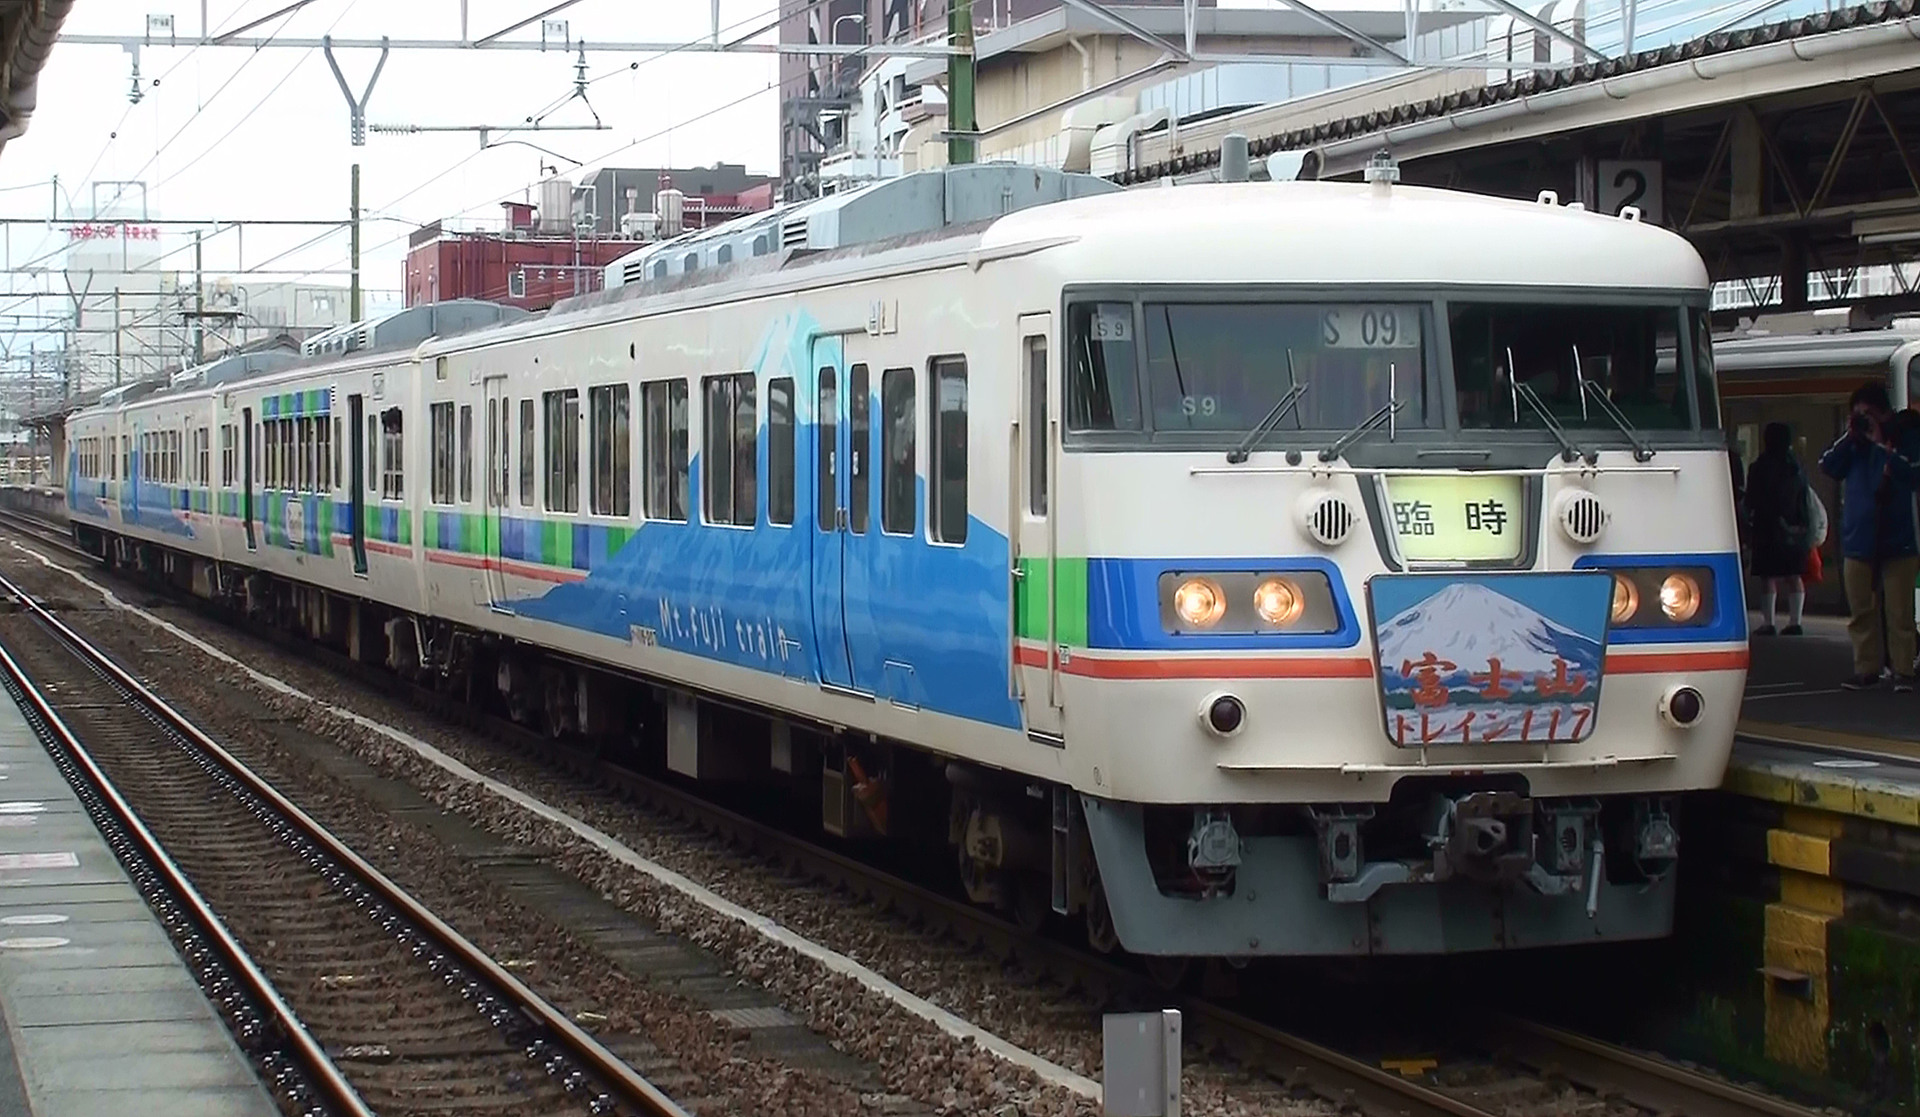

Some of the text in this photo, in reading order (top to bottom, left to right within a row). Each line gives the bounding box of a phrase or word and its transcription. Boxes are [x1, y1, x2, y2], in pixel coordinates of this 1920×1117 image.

[1613, 168, 1647, 218] 2
[1361, 309, 1397, 347] 09
[1393, 498, 1508, 536] 臨時
[735, 616, 791, 662] train
[1401, 651, 1588, 707] 富士山
[1396, 708, 1591, 745] トレイン117
